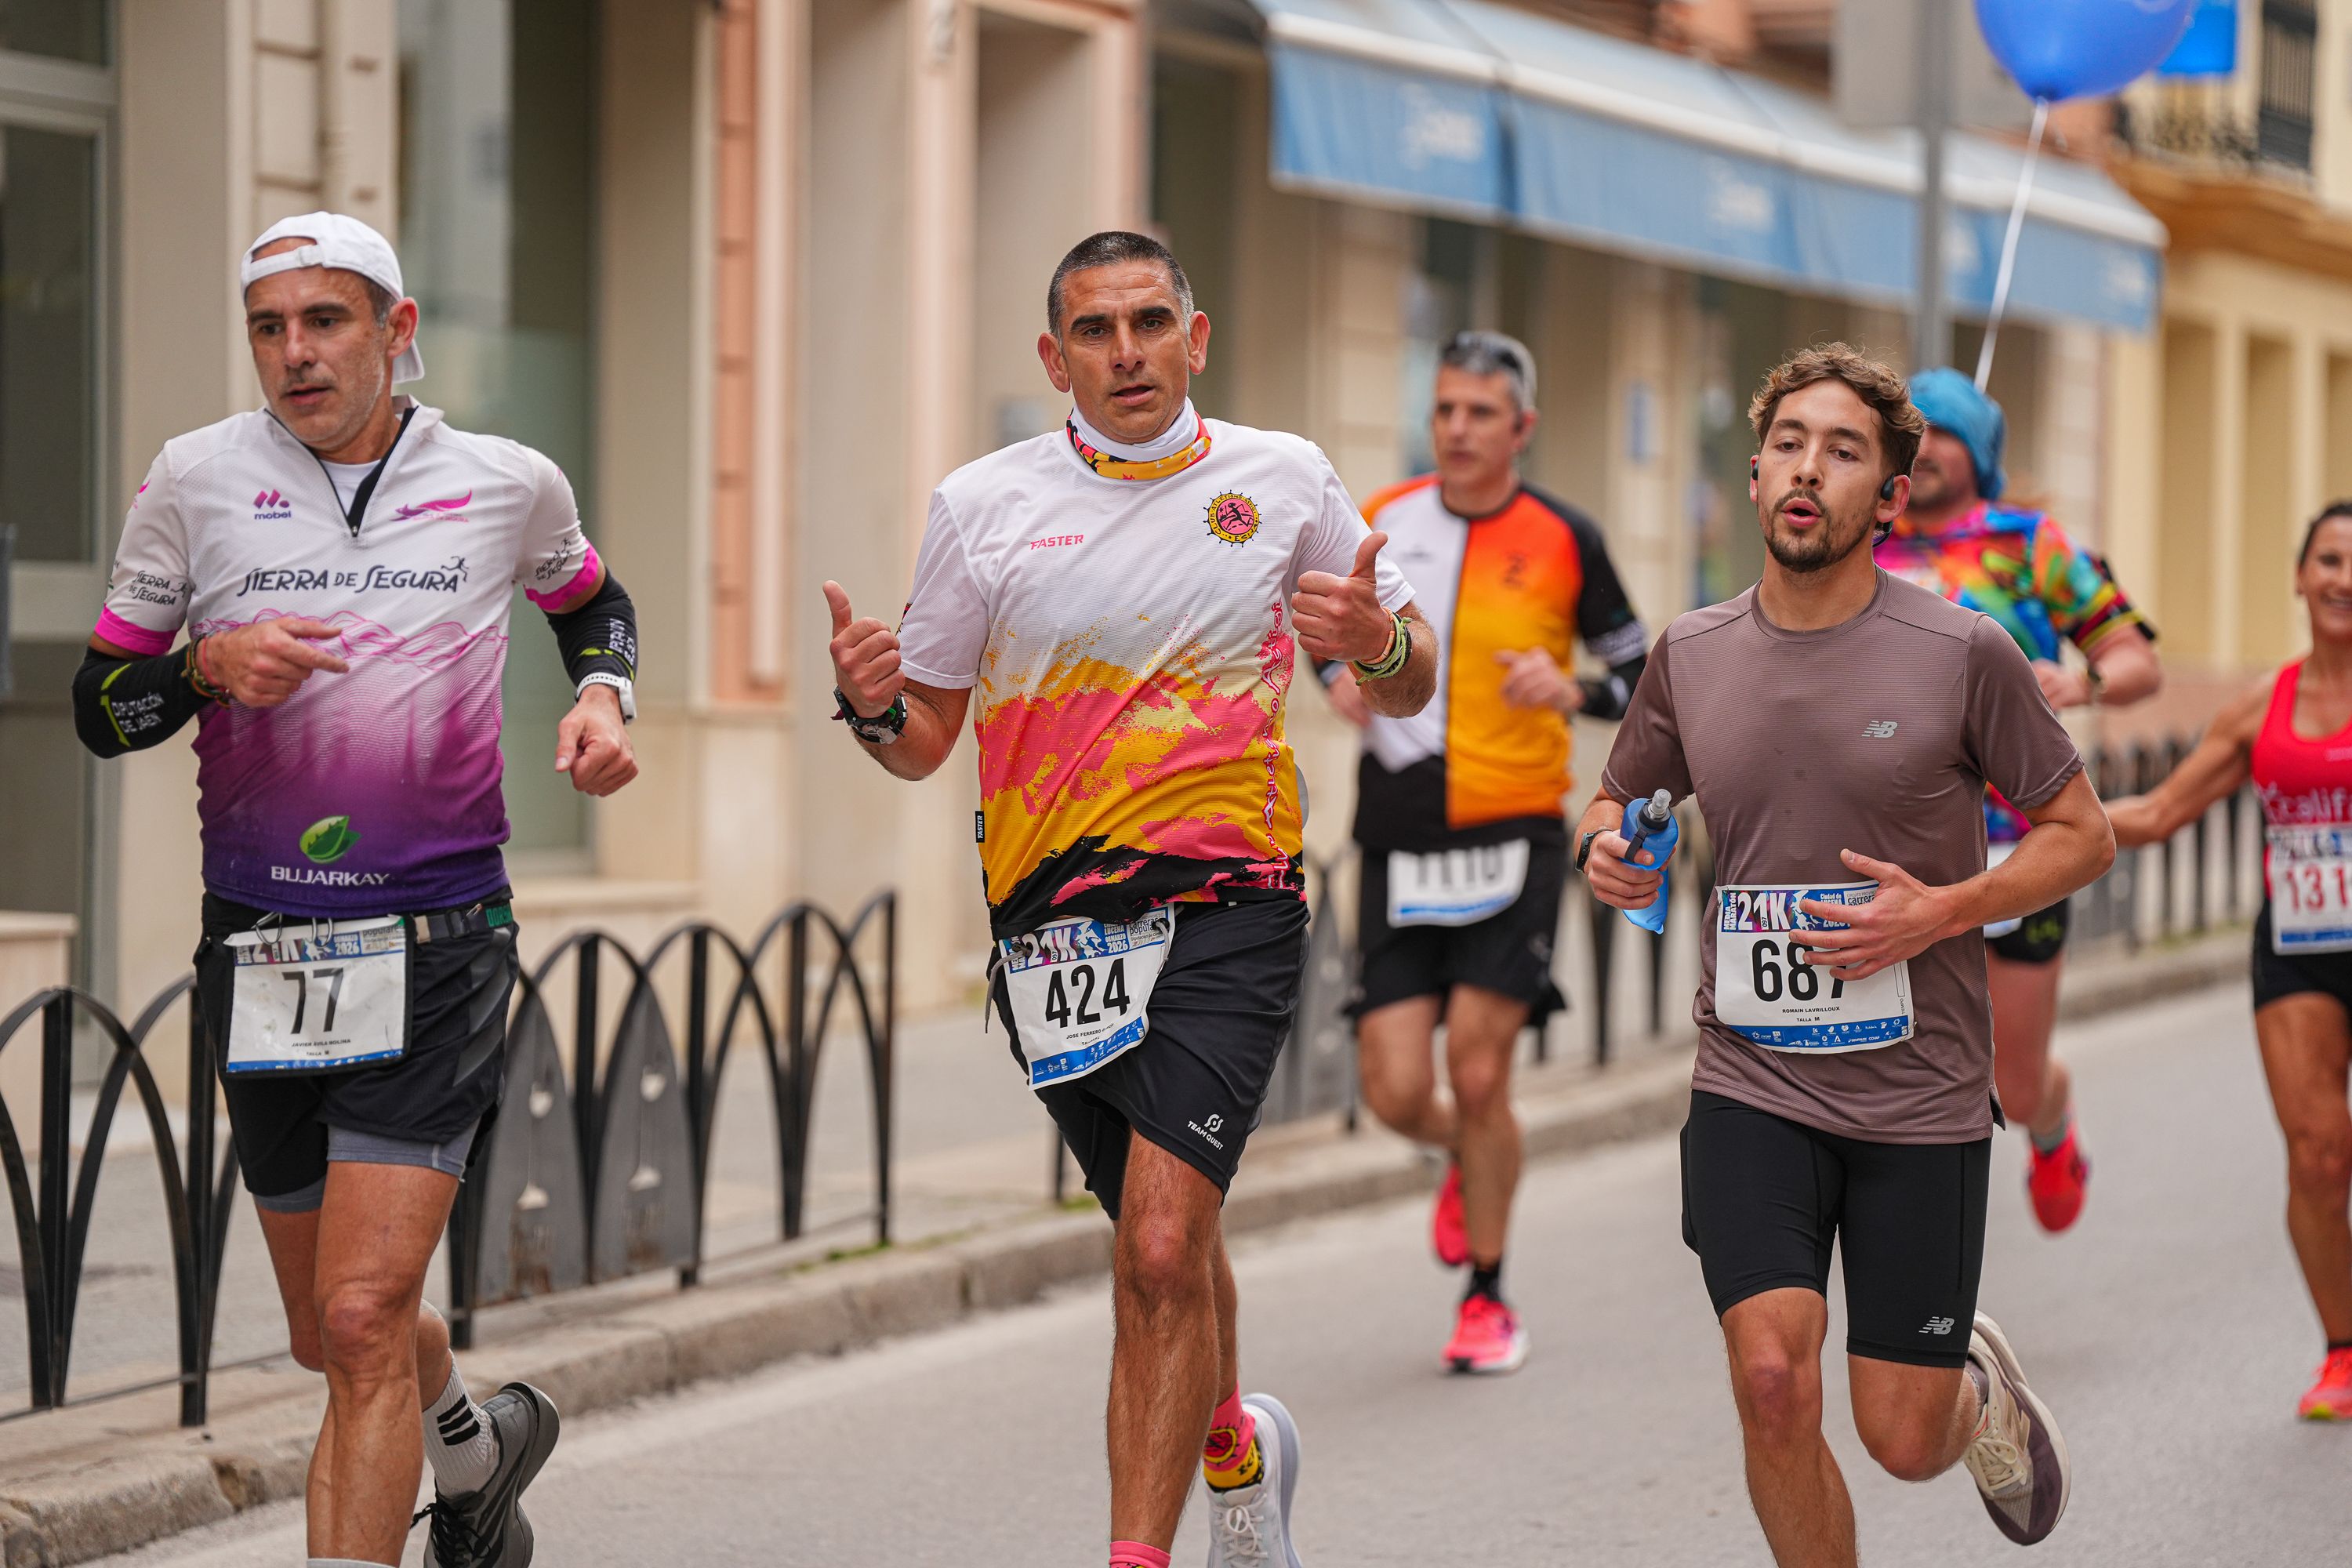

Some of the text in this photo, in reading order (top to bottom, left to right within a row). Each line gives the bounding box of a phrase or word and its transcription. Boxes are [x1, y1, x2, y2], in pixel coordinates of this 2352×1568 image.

[254, 510, 292, 521] mobel
[1210, 513, 1221, 535] CLUB
[1029, 534, 1084, 550] FASTER
[132, 570, 171, 590] SIERRA
[237, 564, 459, 597] SIERRA DE SEGURA
[132, 586, 177, 606] SEGURA
[270, 866, 390, 887] BUJARKAY
[1847, 894, 1875, 905] carrer
[1737, 891, 1791, 931] 21K
[1104, 924, 1125, 935] LUCENA
[334, 942, 361, 956] 2026
[1022, 927, 1078, 967] 21K
[1107, 940, 1129, 954] 2026
[281, 967, 345, 1035] 77
[1045, 957, 1131, 1029] 424
[1080, 1029, 1102, 1037] FERRERO
[1187, 1120, 1224, 1150] TEAM QUEST
